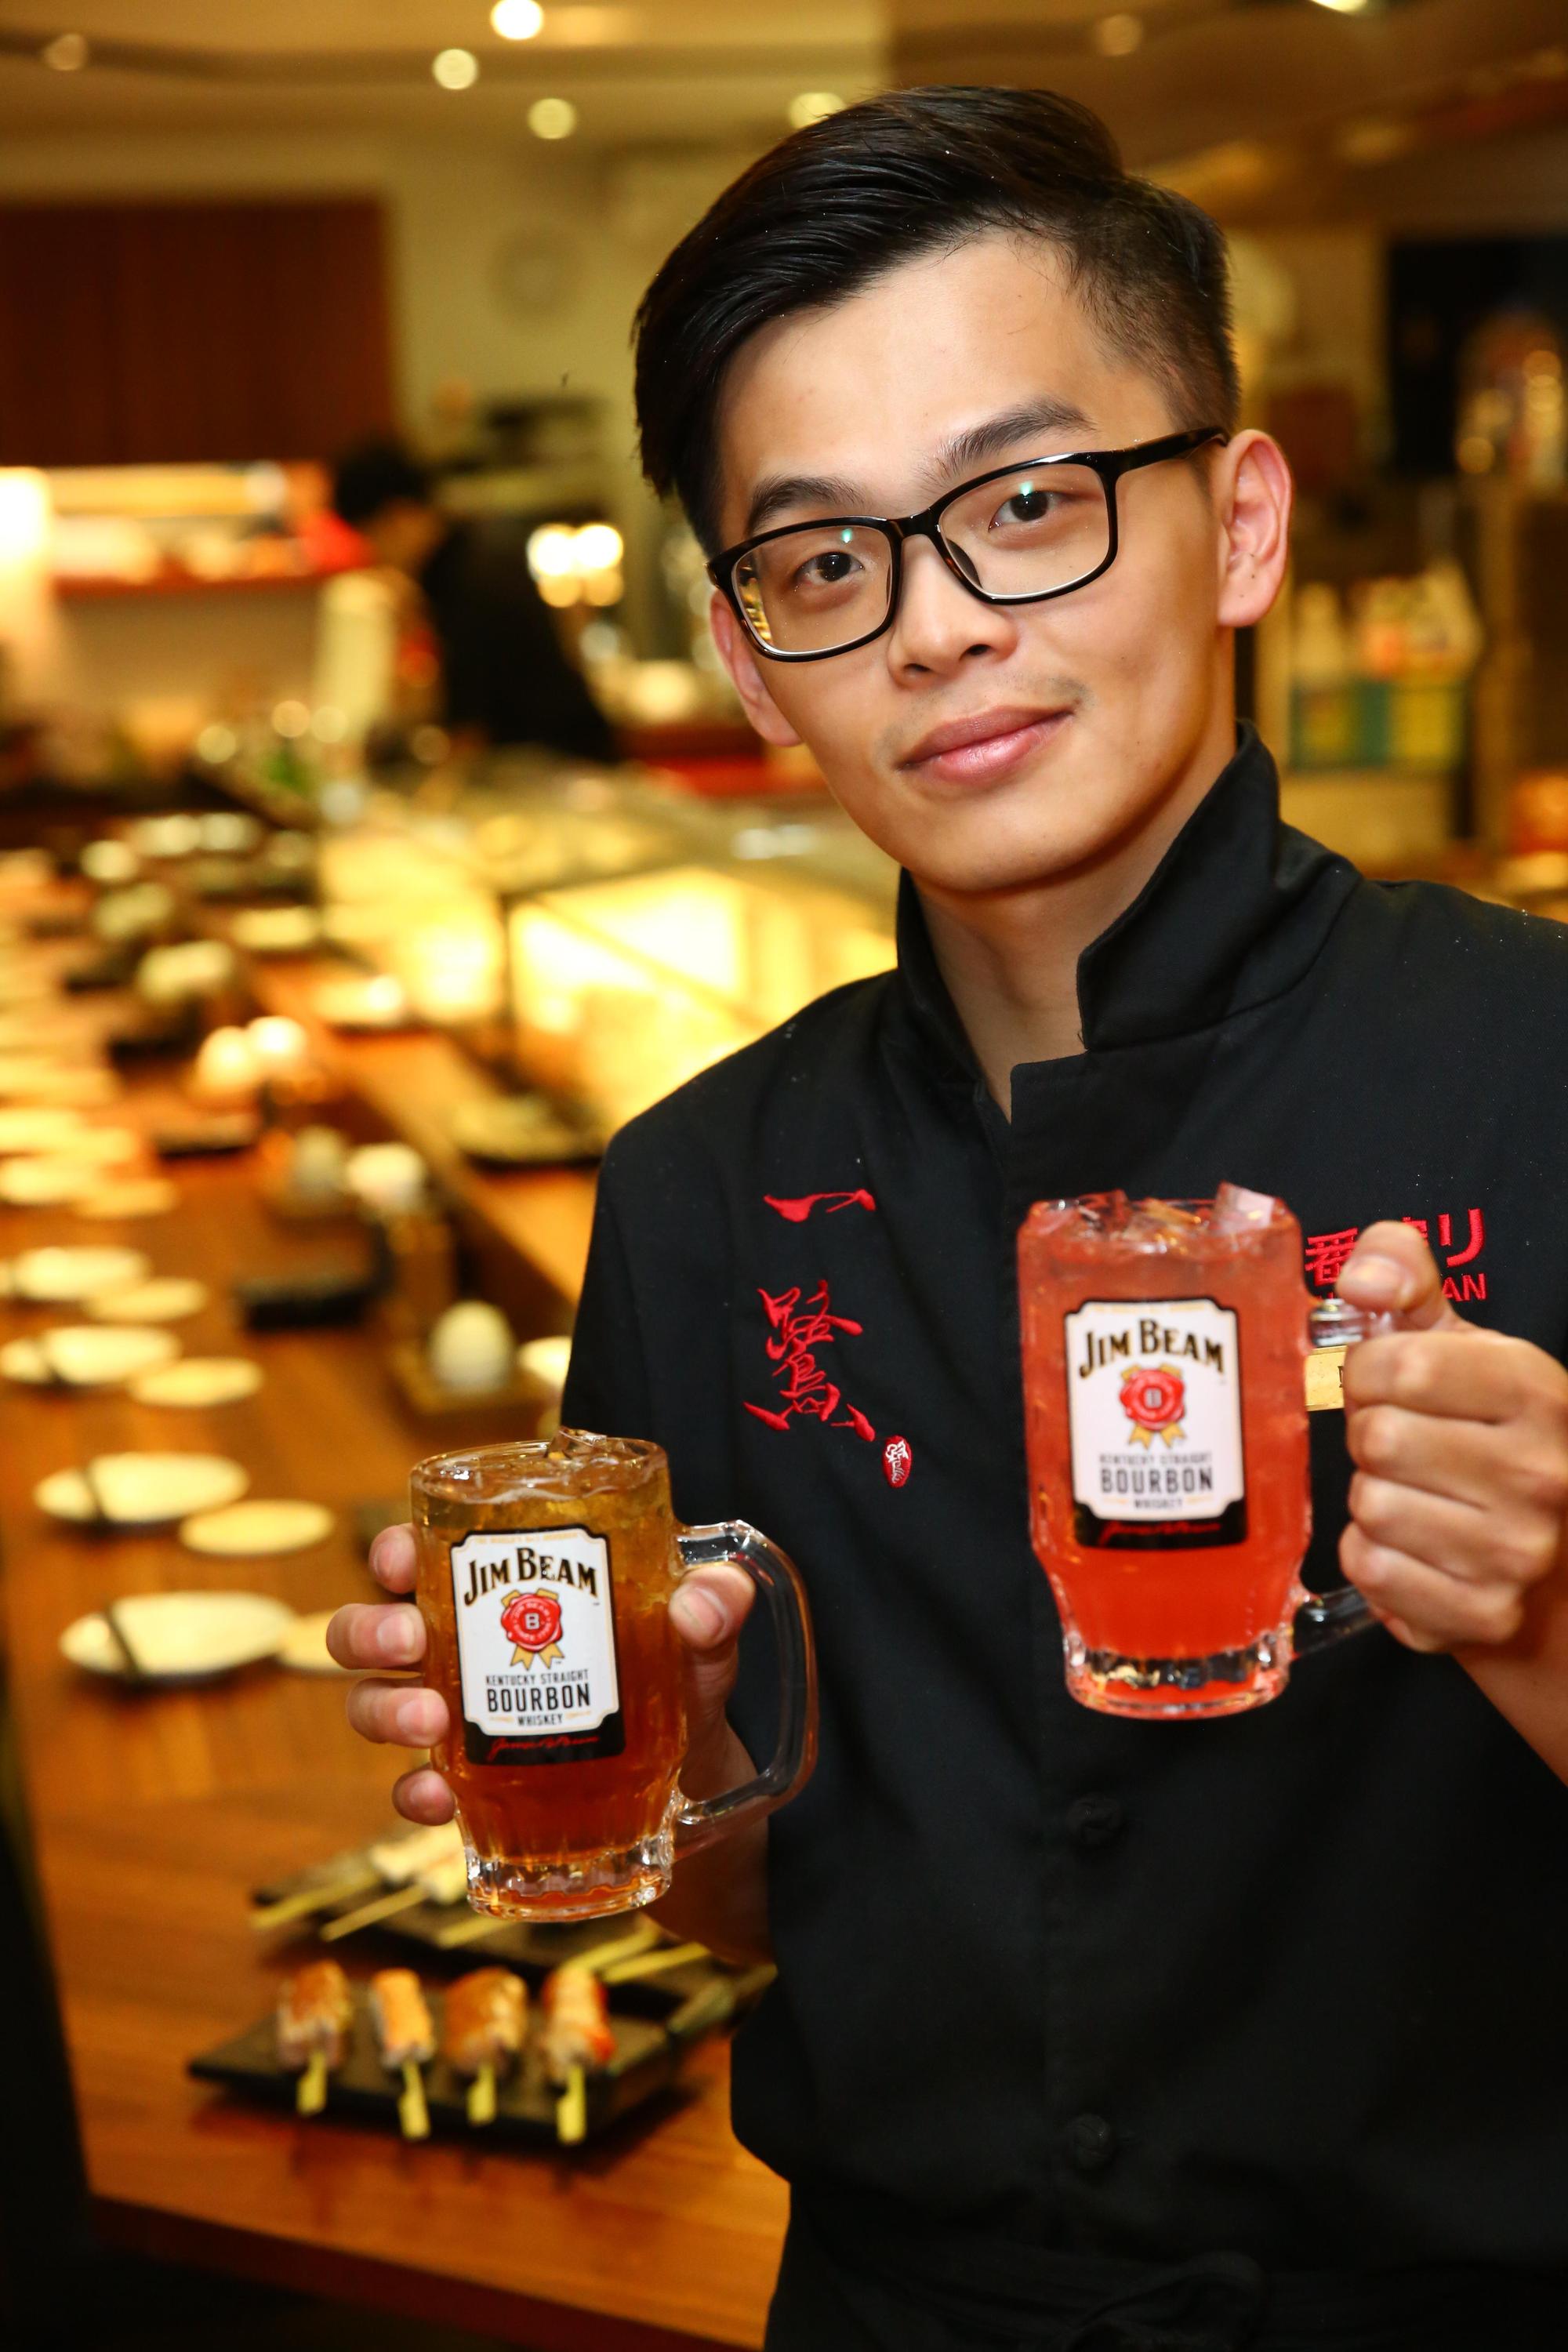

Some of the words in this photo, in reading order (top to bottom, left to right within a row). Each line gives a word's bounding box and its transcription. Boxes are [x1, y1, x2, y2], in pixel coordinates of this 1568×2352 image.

[1079, 1330, 1131, 1378] JIM
[1139, 1318, 1224, 1374] BEAM
[1101, 1467, 1213, 1494] BOURBON
[464, 1558, 510, 1606] JIM
[517, 1547, 598, 1599] BEAM
[524, 1613, 540, 1631] B
[485, 1674, 535, 1686] KENTUCKY
[541, 1668, 589, 1685] STRAIGHT
[487, 1683, 591, 1712] BOURBON
[517, 1712, 564, 1726] WHISKEY
